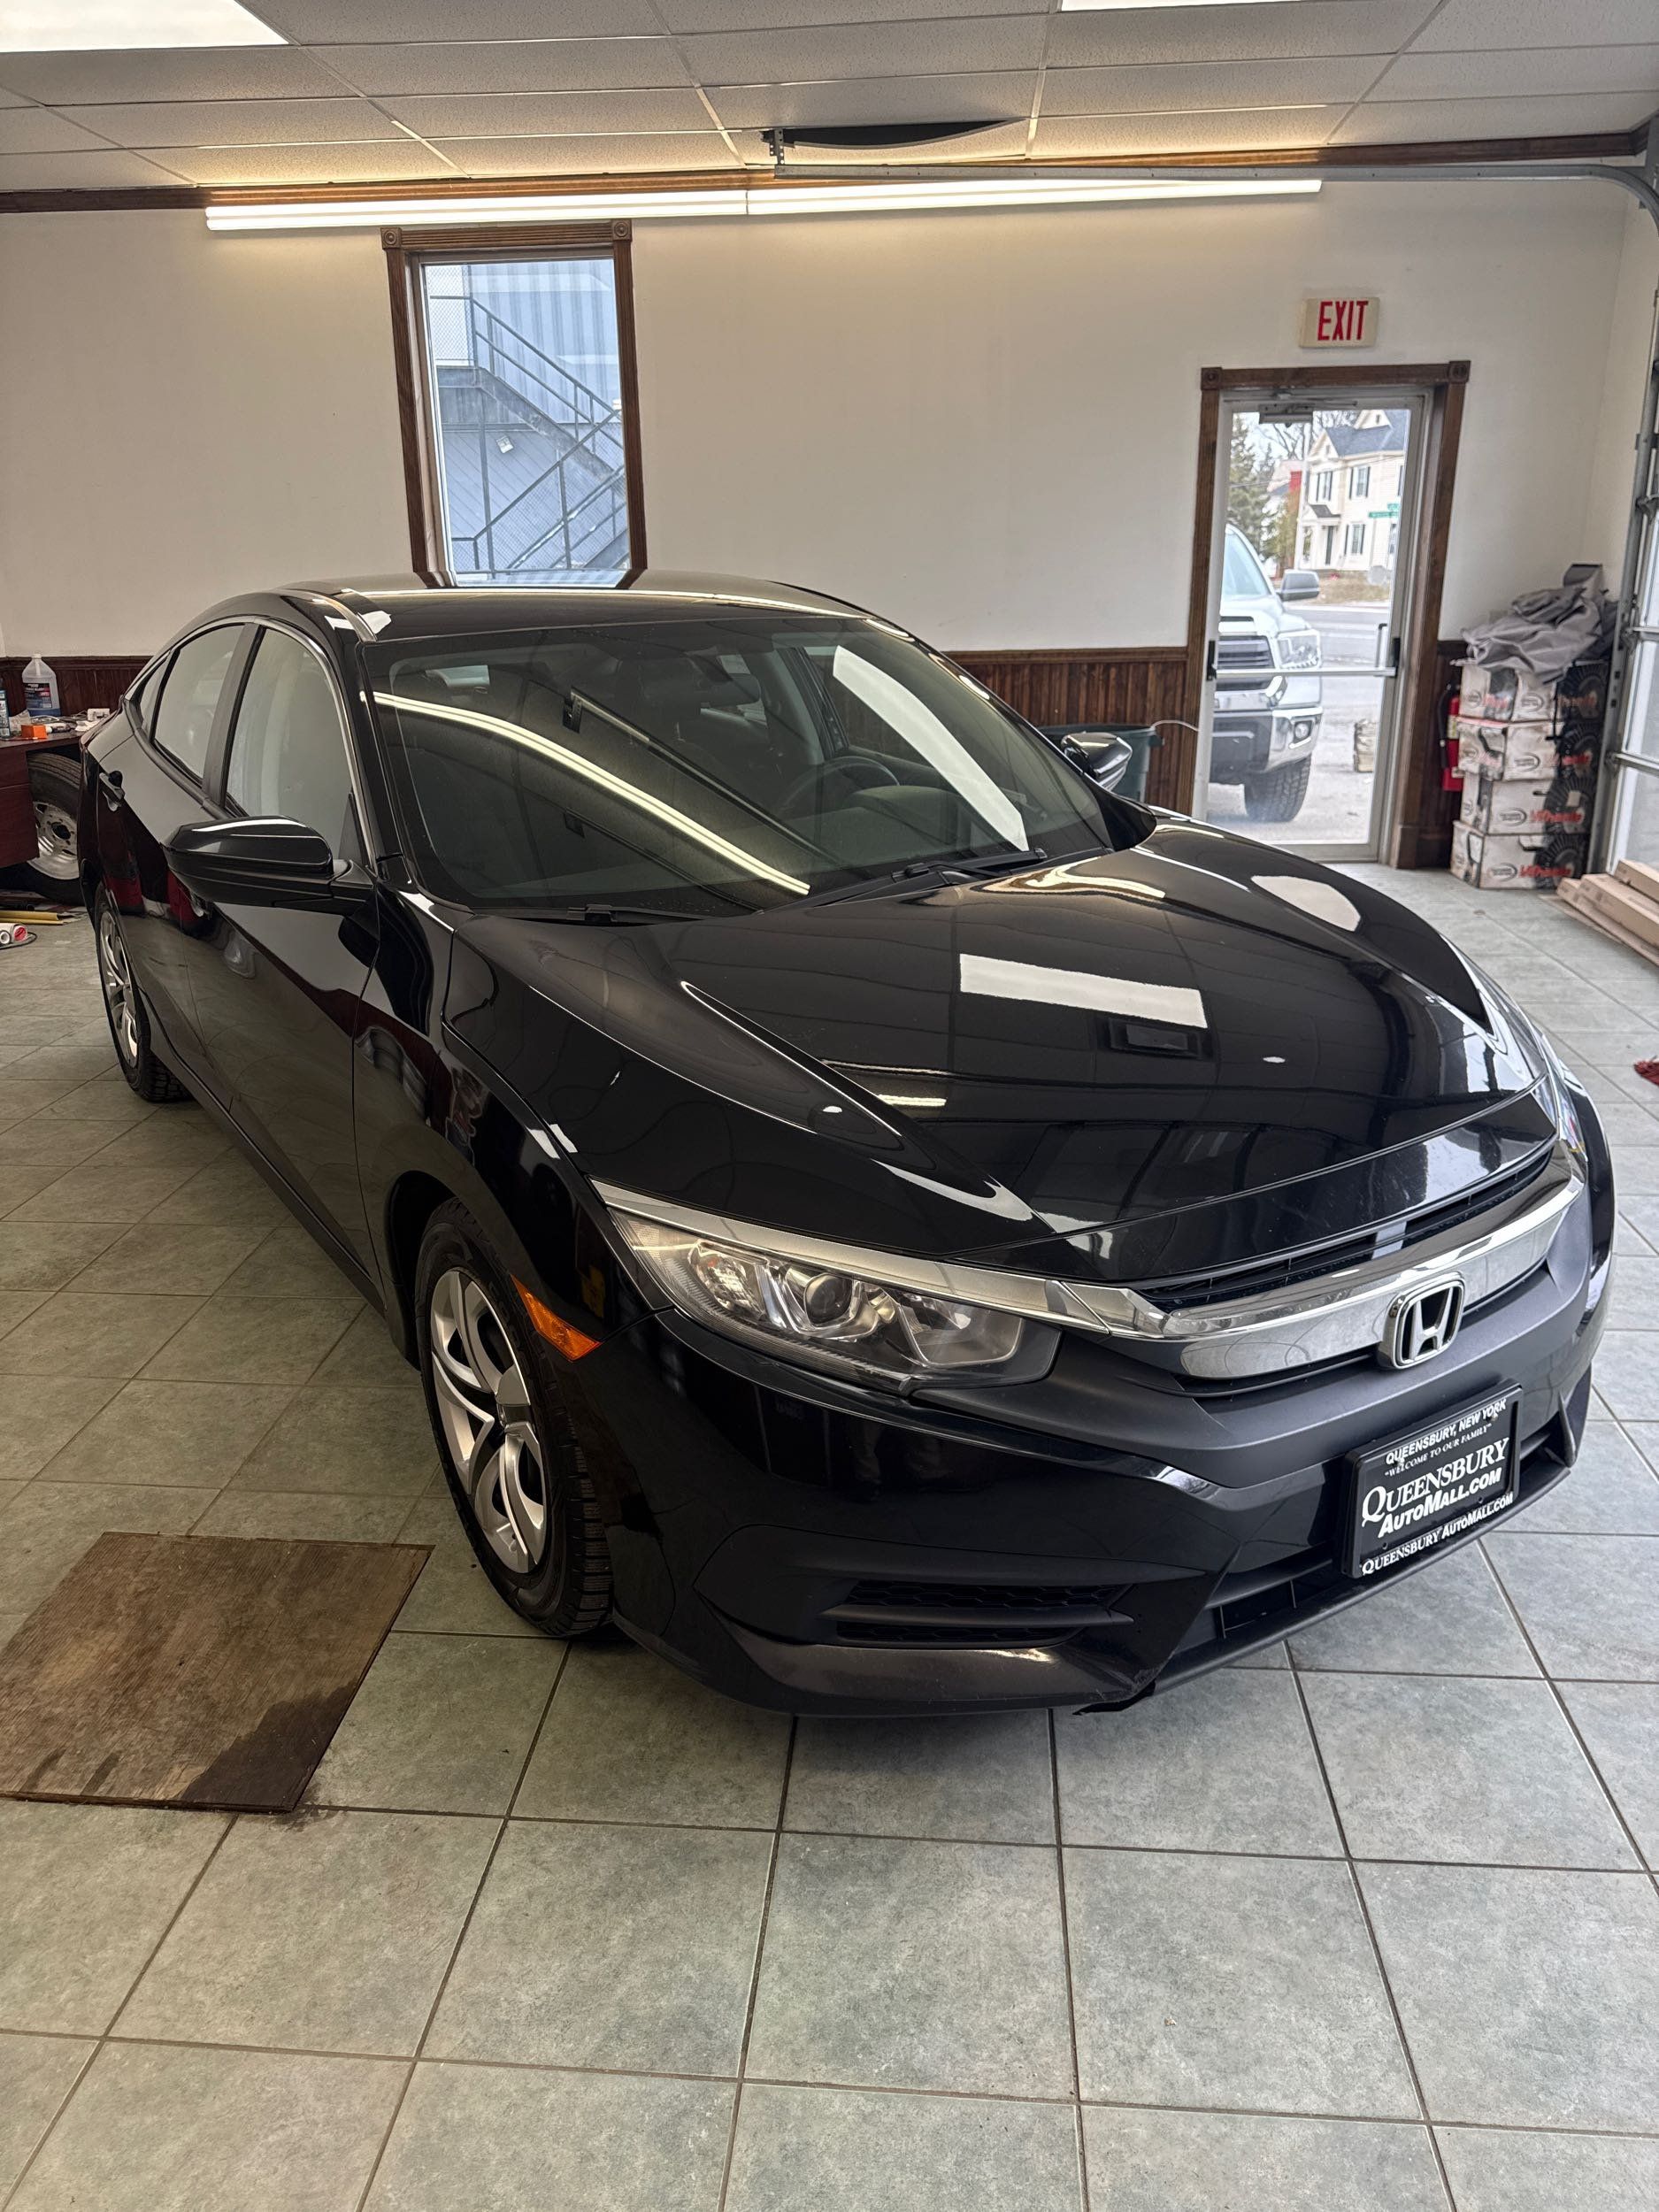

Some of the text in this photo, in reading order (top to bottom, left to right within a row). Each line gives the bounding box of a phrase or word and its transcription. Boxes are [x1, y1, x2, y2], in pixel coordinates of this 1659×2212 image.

[1317, 300, 1369, 341] EXIT
[1386, 1398, 1507, 1465] QUEENSBURY, NEW YORK
[1430, 1447, 1441, 1458] TO
[1442, 1439, 1460, 1452] OUR
[1362, 1437, 1509, 1528] QUEENSBURY
[1378, 1467, 1502, 1539] AUTOMALL.COM
[1362, 1491, 1514, 1576] QUEENSBURY AUTOMALL.COM
